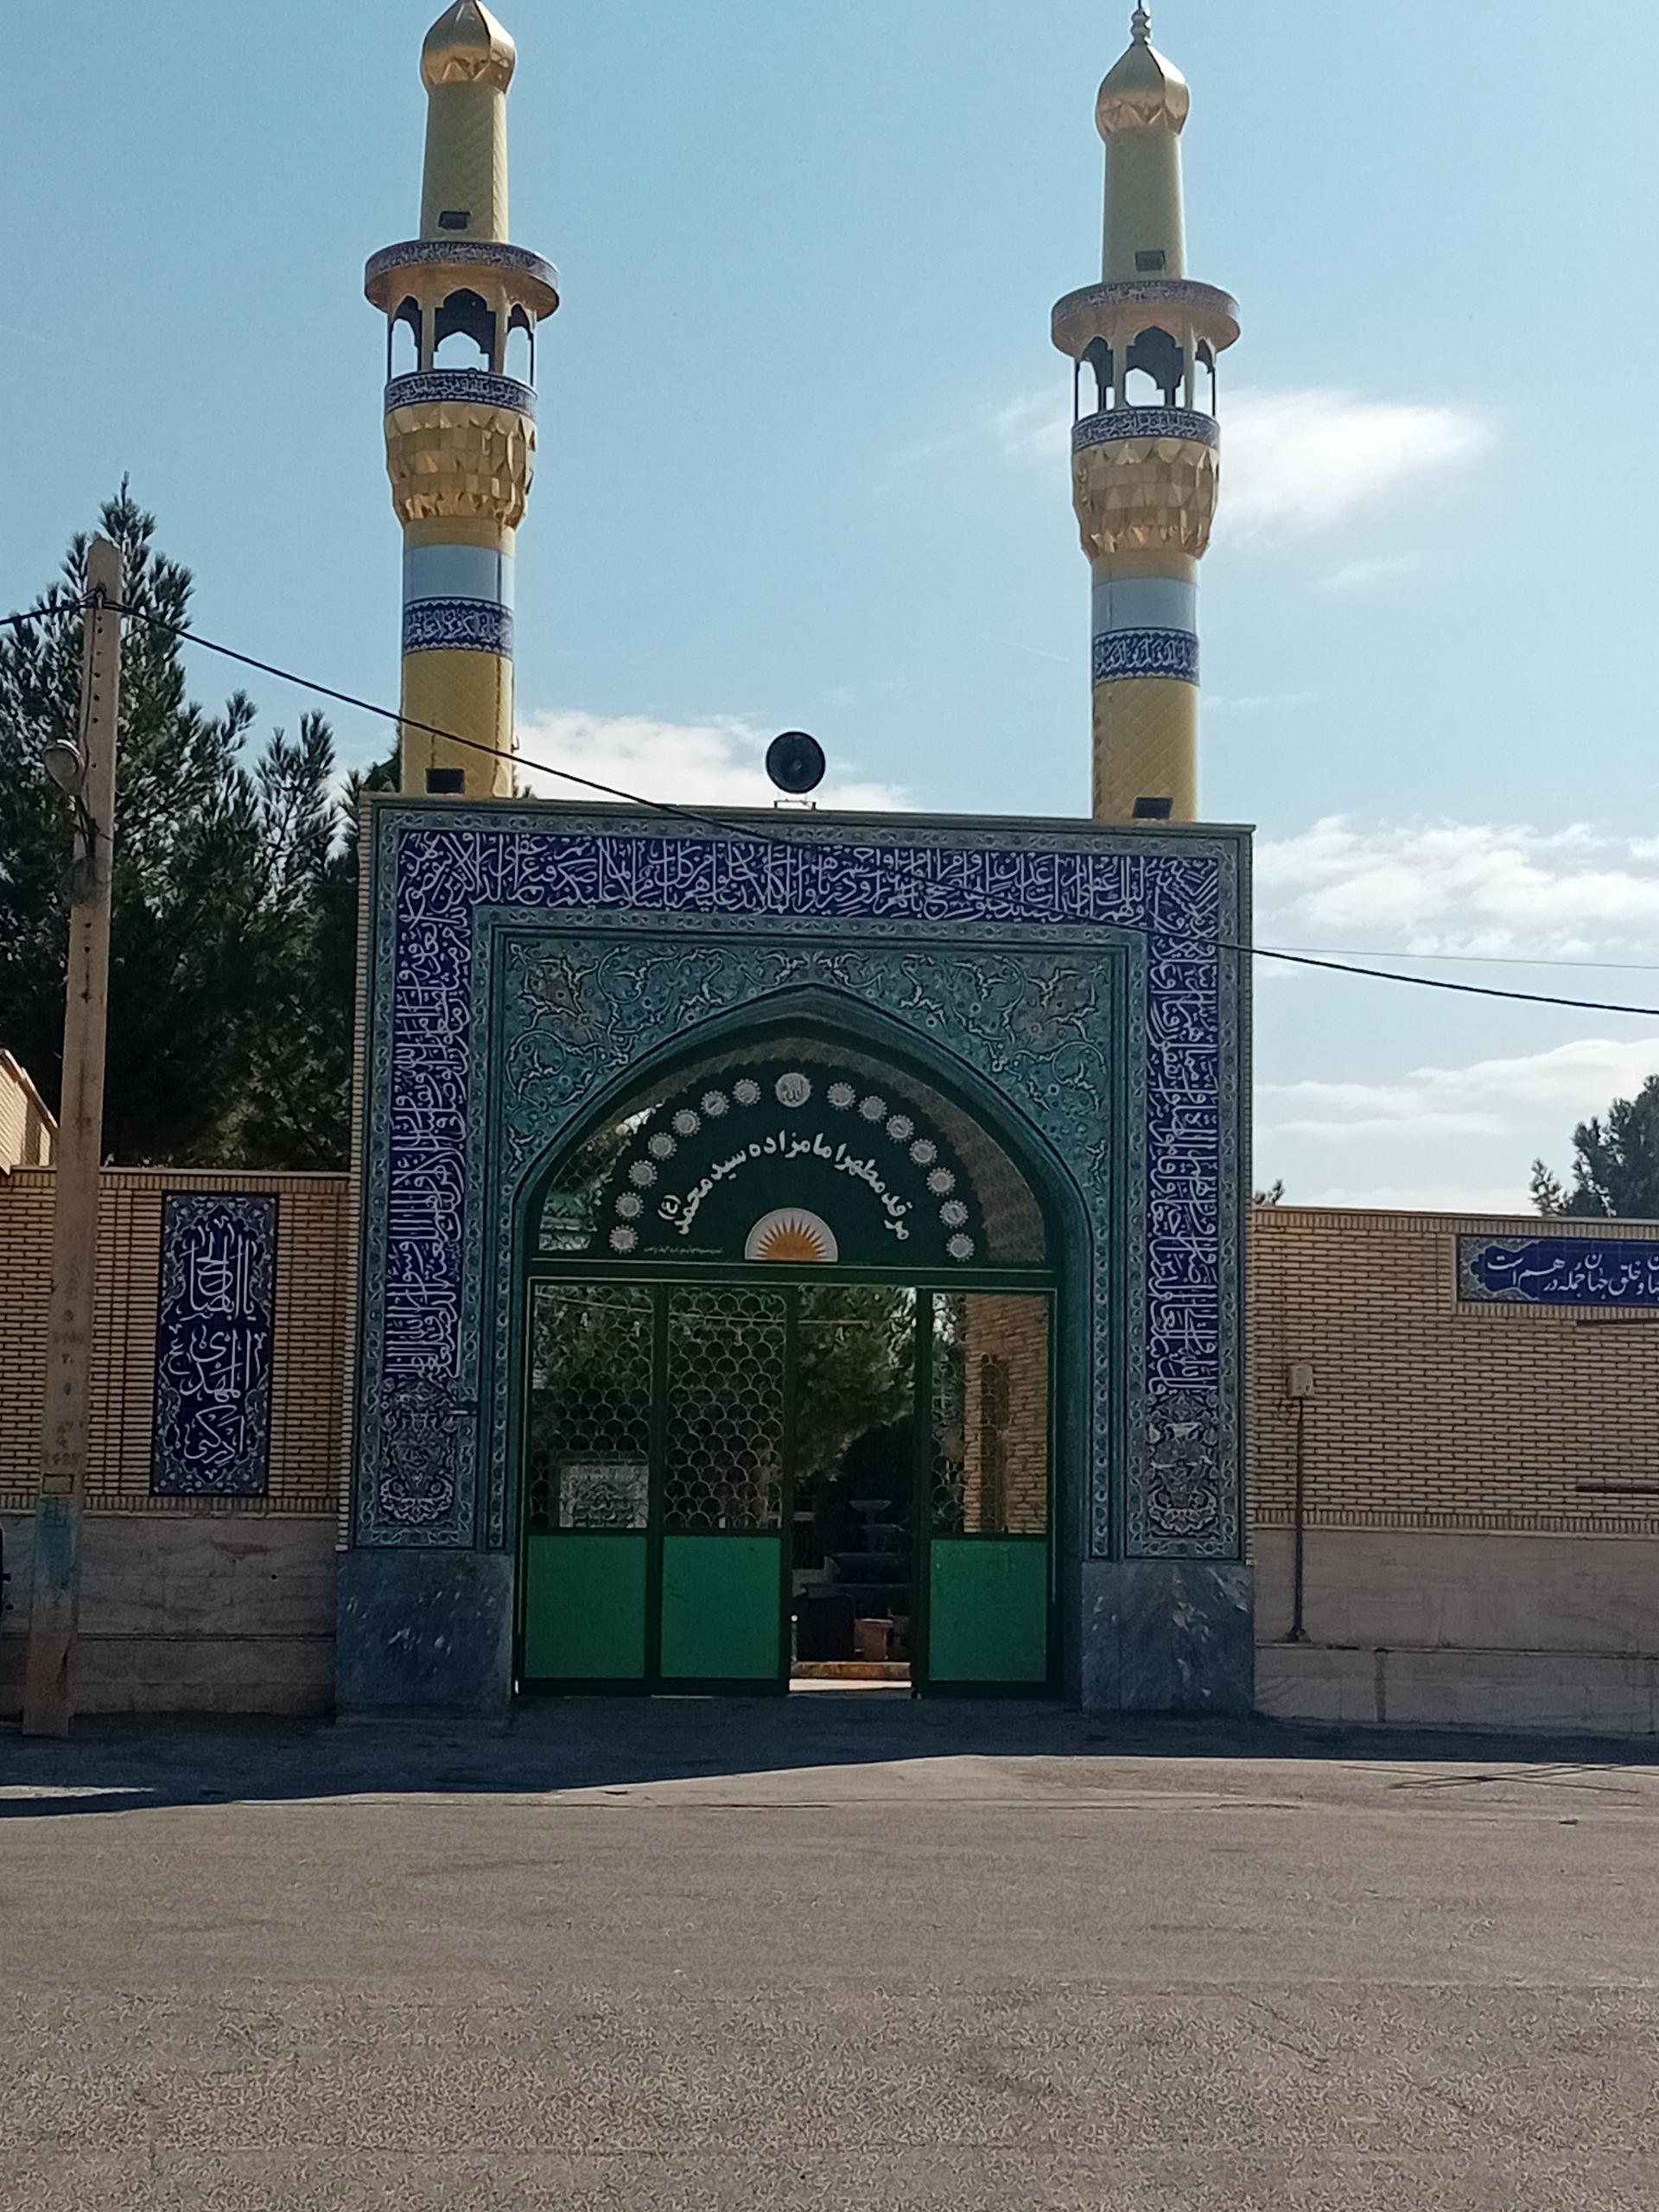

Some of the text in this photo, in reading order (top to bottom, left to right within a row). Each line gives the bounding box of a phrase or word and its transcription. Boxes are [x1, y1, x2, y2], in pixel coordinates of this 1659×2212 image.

[711, 1150, 747, 1180] سید
[834, 1155, 886, 1193] مطهر
[674, 1179, 714, 1236] محمد
[881, 1193, 912, 1240] مرقد
[1542, 1278, 1559, 1293] در
[1558, 1266, 1586, 1299] جمله
[1584, 1252, 1609, 1300] جهان
[1608, 1260, 1642, 1296] خلق
[1636, 1282, 1644, 1295] و
